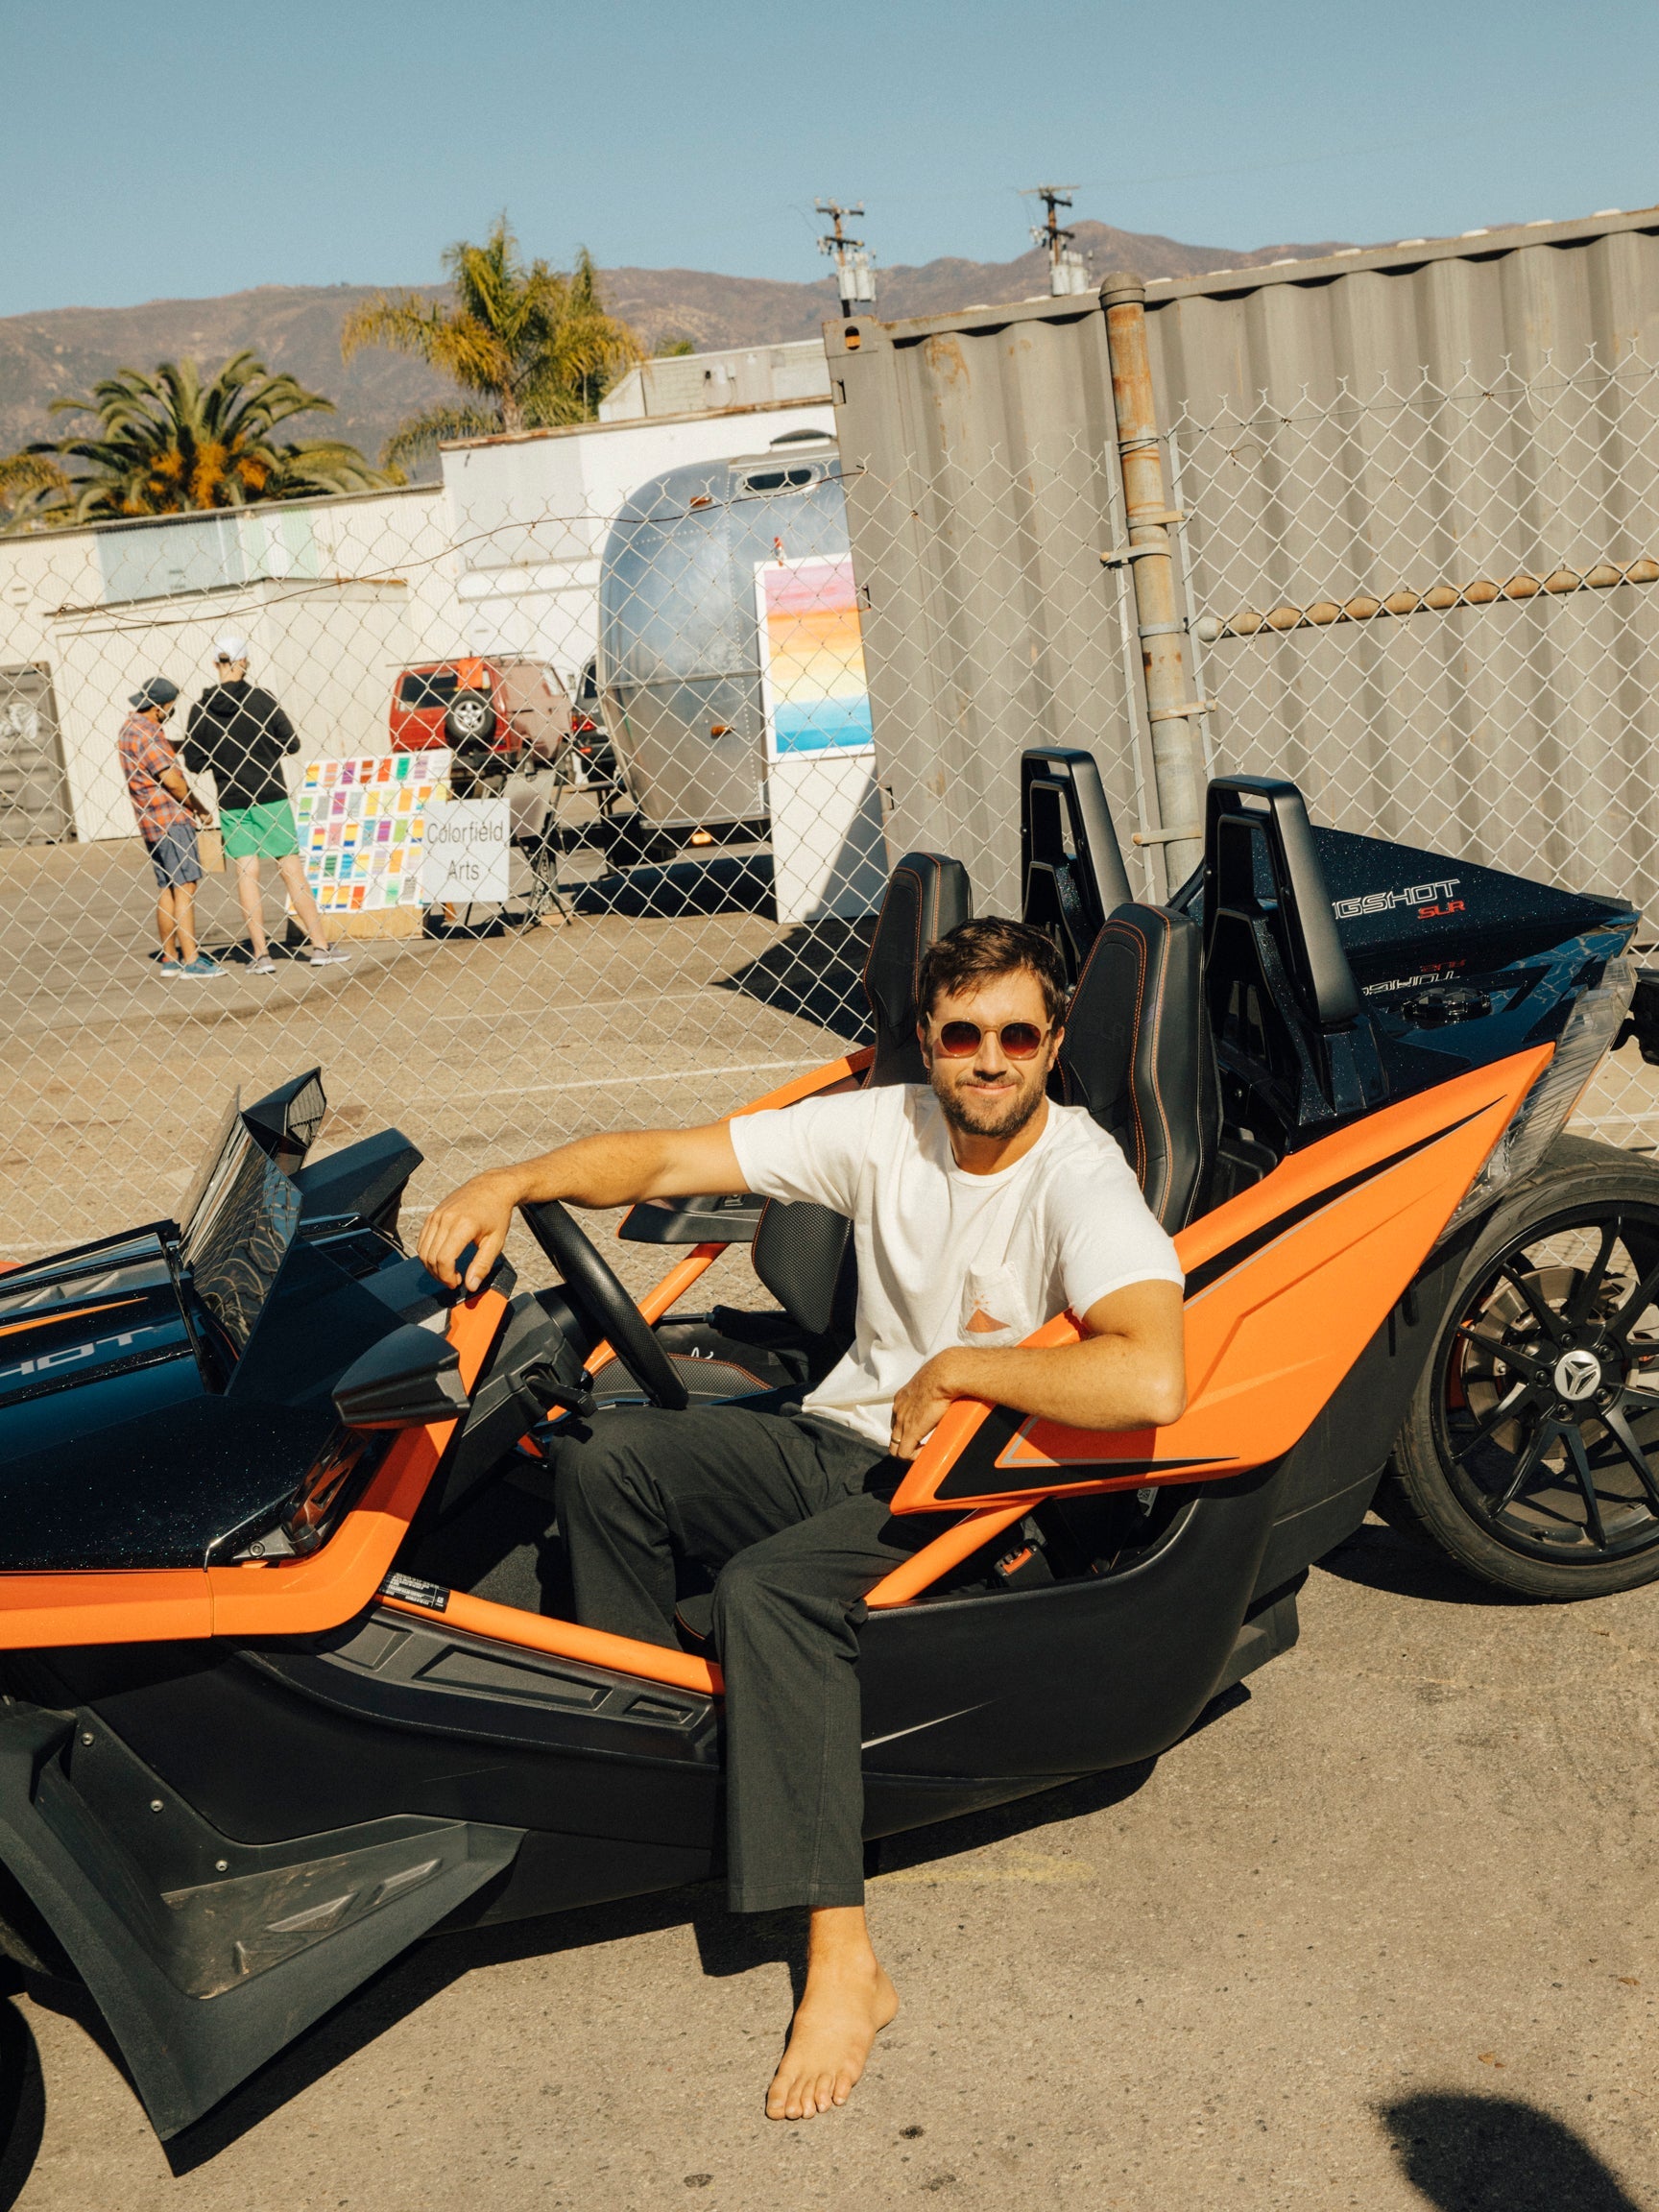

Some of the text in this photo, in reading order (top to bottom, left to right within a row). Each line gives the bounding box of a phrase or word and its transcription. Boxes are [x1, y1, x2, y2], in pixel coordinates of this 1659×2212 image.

[427, 820, 504, 844] Colorfield
[447, 859, 480, 880] Arts
[1332, 878, 1461, 920] GSHOT
[1417, 900, 1467, 920] SLR
